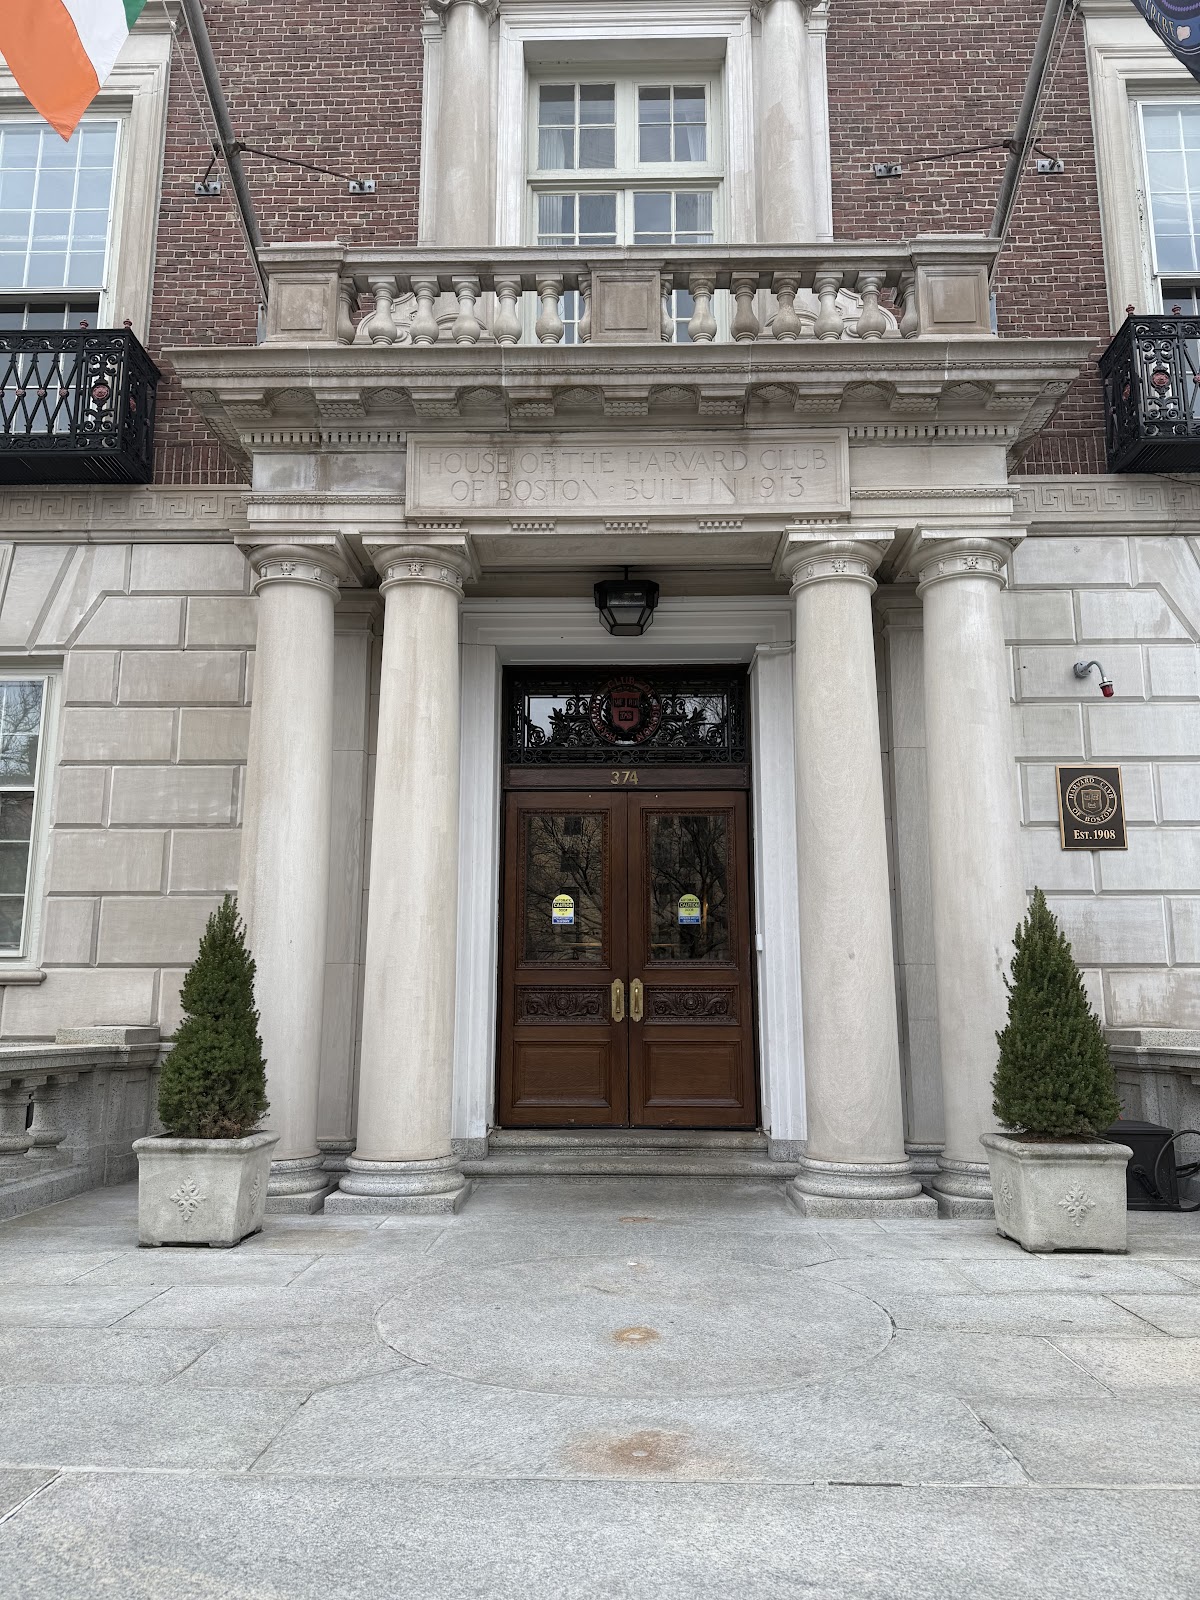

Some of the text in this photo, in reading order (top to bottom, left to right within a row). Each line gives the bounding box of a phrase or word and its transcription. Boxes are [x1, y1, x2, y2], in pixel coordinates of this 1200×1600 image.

[426, 448, 829, 475] HOUSE OF THE HARVARD CLUB
[450, 475, 805, 502] OF BOSTON BUILT IN 1913
[607, 676, 635, 690] CLUB
[610, 770, 639, 785] 374
[1068, 777, 1095, 800] HARVARD
[1072, 806, 1113, 823] OF BOSTON
[1093, 829, 1116, 840] 1908
